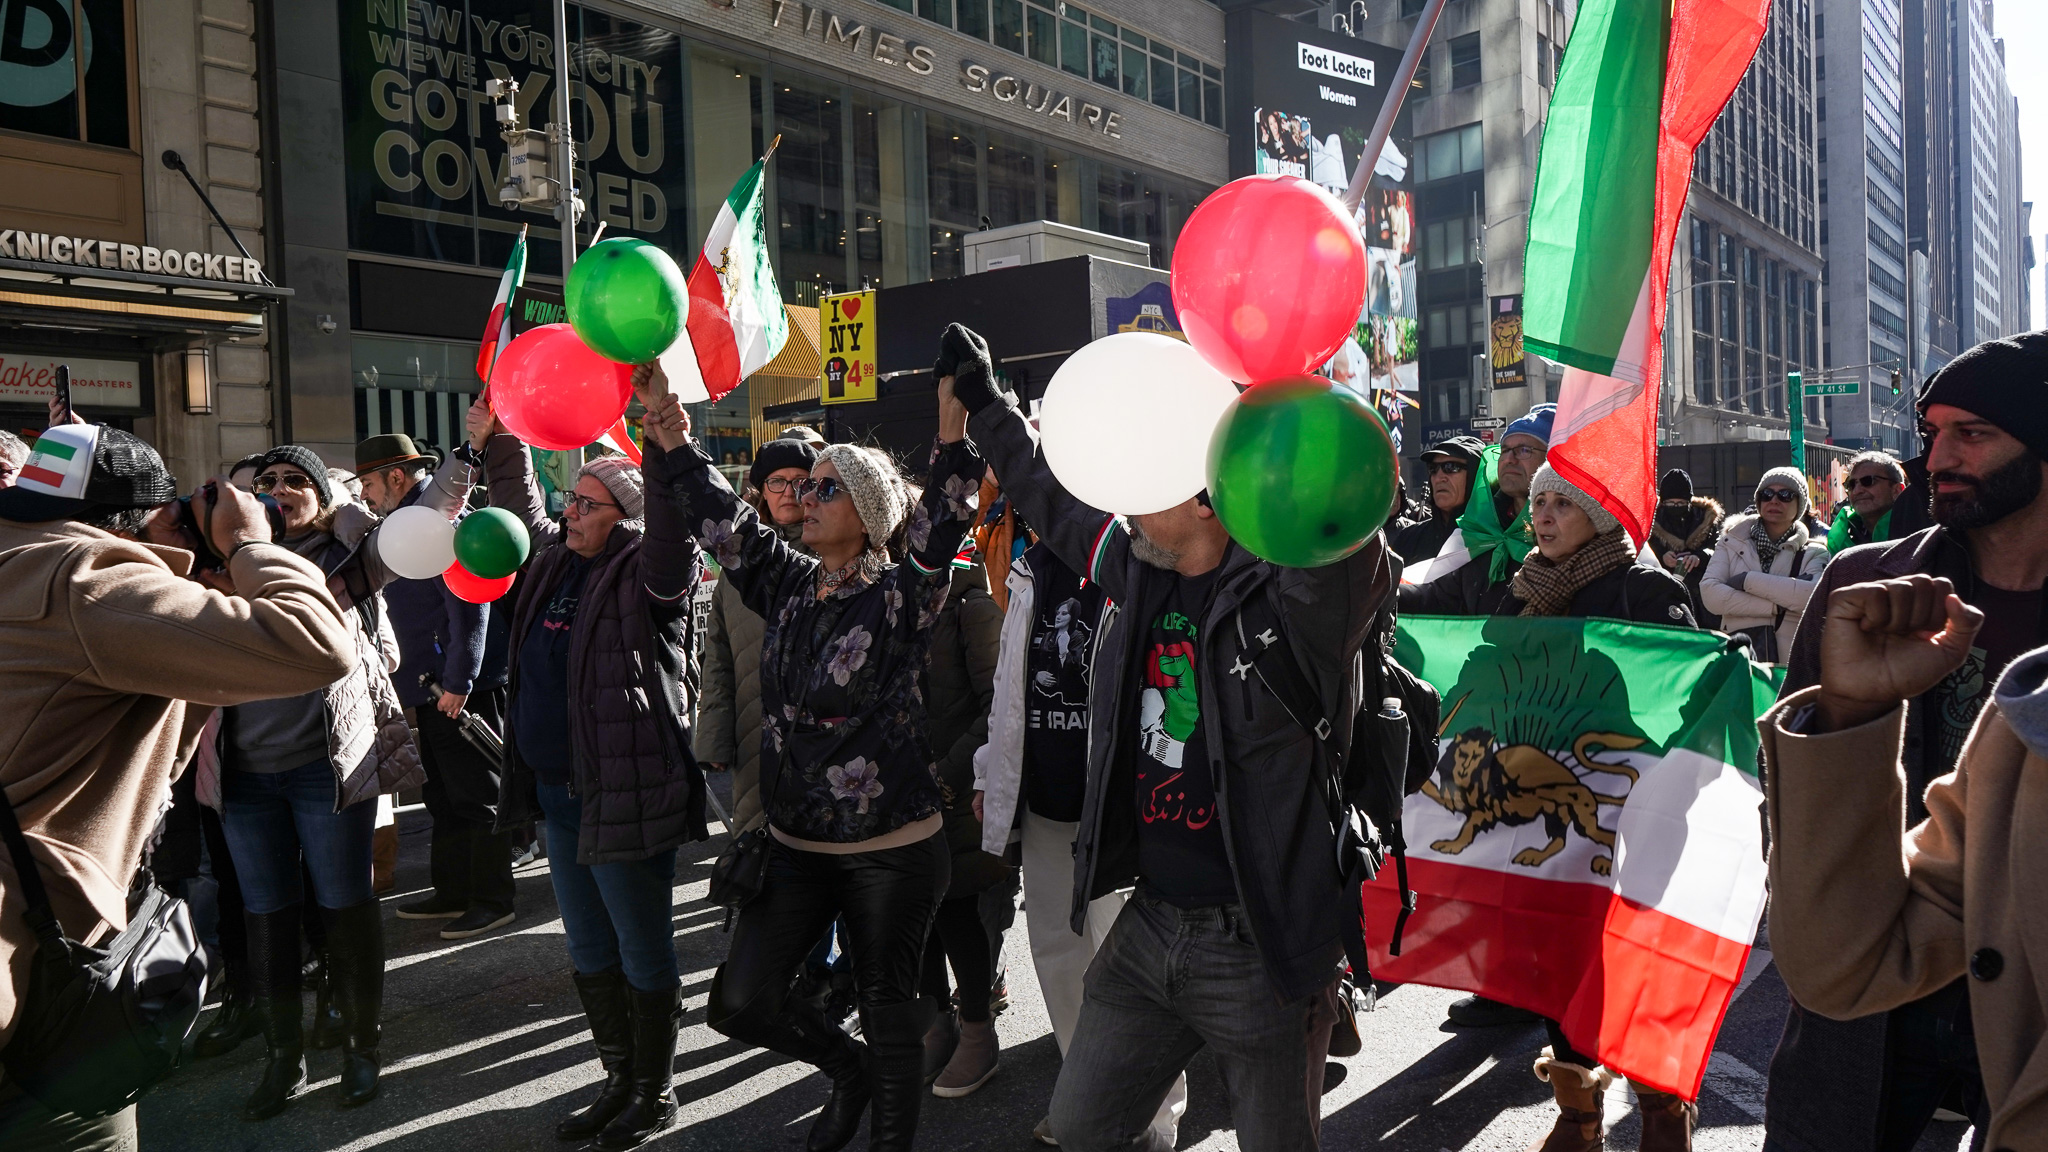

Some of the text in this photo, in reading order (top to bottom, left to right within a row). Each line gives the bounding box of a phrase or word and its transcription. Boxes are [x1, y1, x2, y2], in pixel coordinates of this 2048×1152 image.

[366, 0, 463, 45] NEW
[588, 48, 662, 96] CITY
[1302, 47, 1372, 81] Foot Locker
[370, 68, 488, 139] GOT
[965, 64, 1123, 140] SQUARE
[1318, 84, 1357, 108] Women
[373, 129, 668, 234] COVRED
[0, 228, 263, 285] KNICKERBOCKER
[831, 299, 840, 323] I
[1144, 305, 1158, 315] NYC
[829, 322, 864, 354] NY
[71, 378, 133, 389] ROASTERS
[1428, 428, 1464, 440] PARIS
[1491, 419, 1502, 427] WAY
